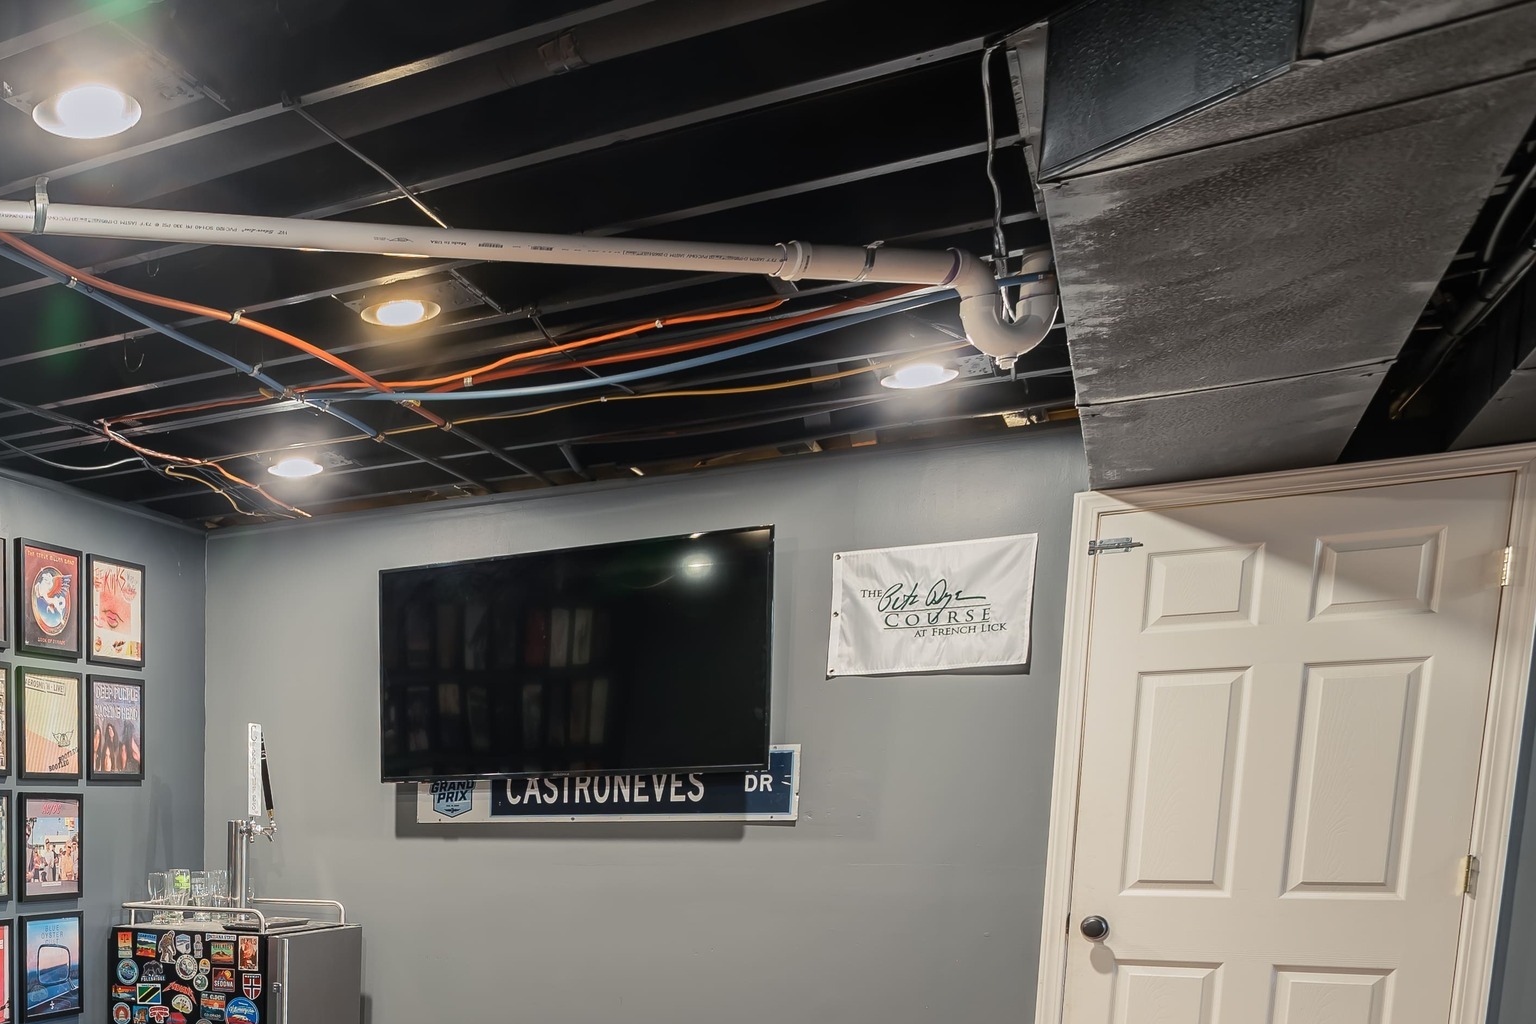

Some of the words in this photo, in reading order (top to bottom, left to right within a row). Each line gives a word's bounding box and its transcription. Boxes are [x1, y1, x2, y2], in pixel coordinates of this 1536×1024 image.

[860, 589, 883, 598] THE
[884, 607, 991, 628] COURSE
[431, 781, 476, 795] GRAND
[506, 772, 705, 805] CASTRONEVES
[744, 774, 773, 792] DR
[437, 790, 469, 804] PRIX
[45, 924, 60, 932] BLUE
[41, 931, 64, 940] OYSTER
[214, 980, 234, 988] SEDONA
